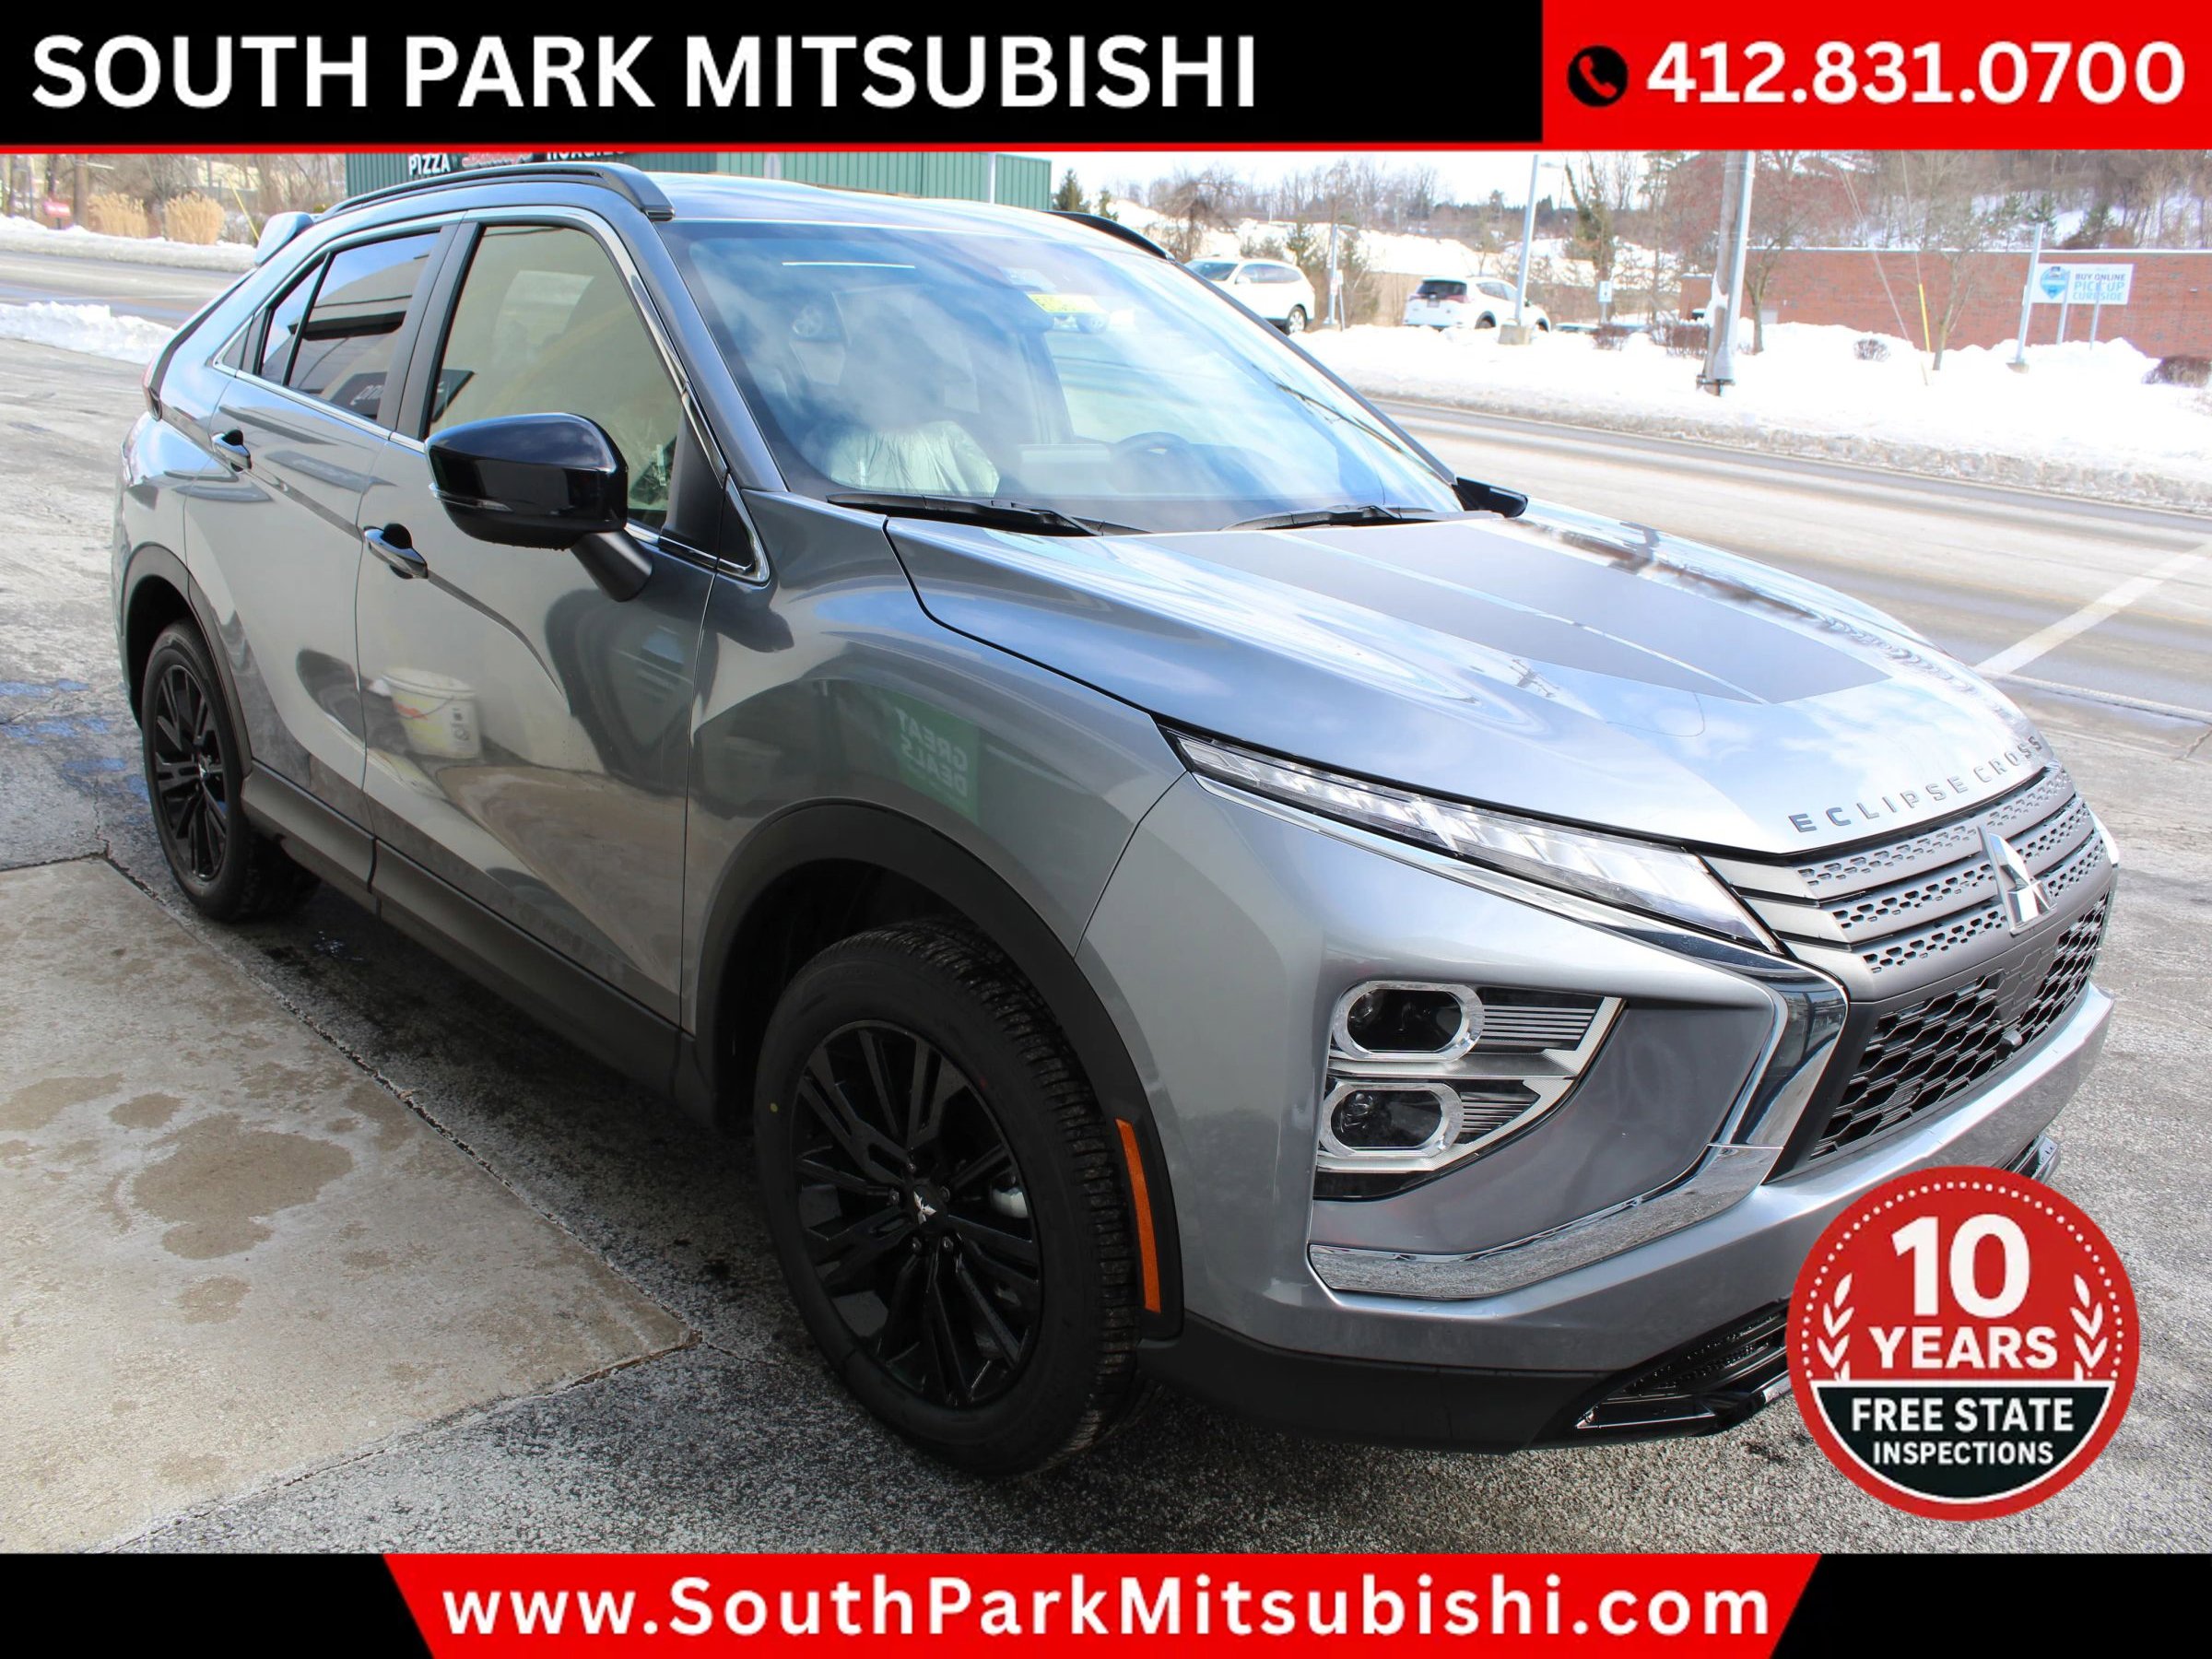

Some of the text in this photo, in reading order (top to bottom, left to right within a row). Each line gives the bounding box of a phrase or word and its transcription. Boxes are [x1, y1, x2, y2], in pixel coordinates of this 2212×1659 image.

[408, 153, 451, 176] PIZZA
[2075, 273, 2126, 281] BUY ONLINE
[2106, 281, 2125, 291] UP
[1788, 735, 2043, 833] ECLIPSE CROSS
